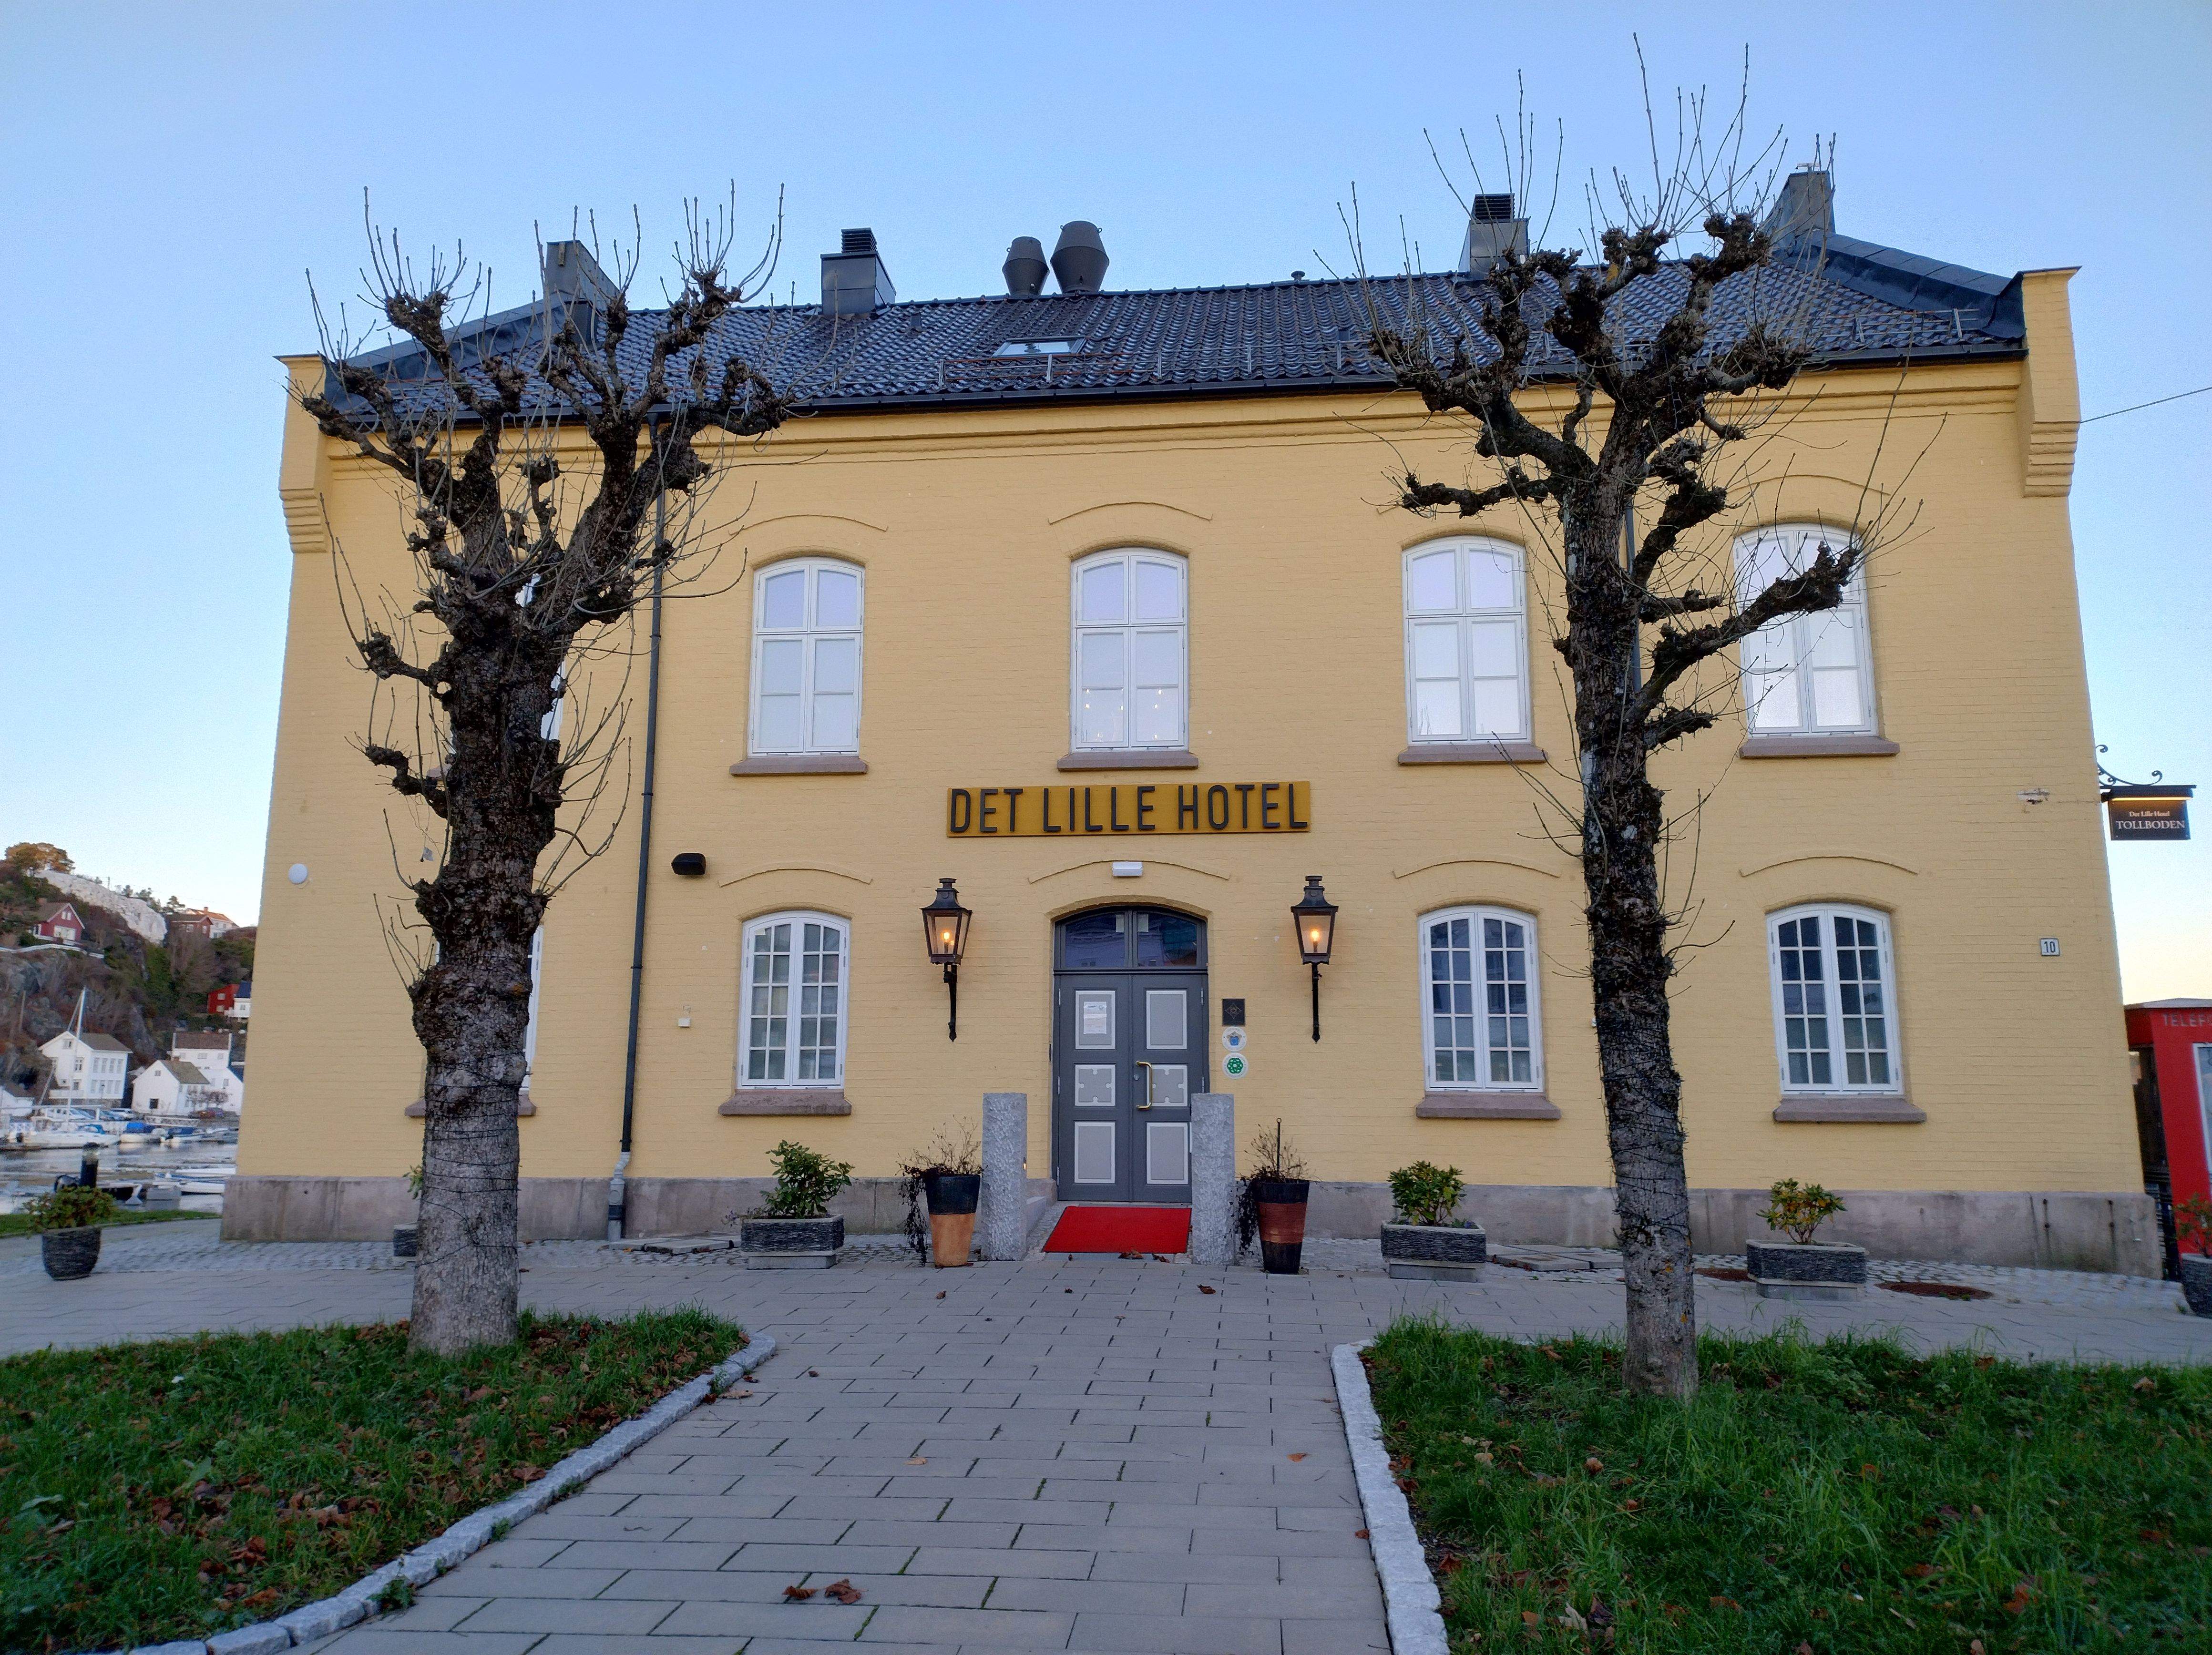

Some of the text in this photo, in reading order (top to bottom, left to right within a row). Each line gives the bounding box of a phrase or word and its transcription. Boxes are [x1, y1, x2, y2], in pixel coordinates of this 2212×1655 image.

[950, 783, 1308, 832] DET LILLE HOTEL
[2115, 820, 2185, 829] TOLLBODEN
[2043, 940, 2056, 953] 10
